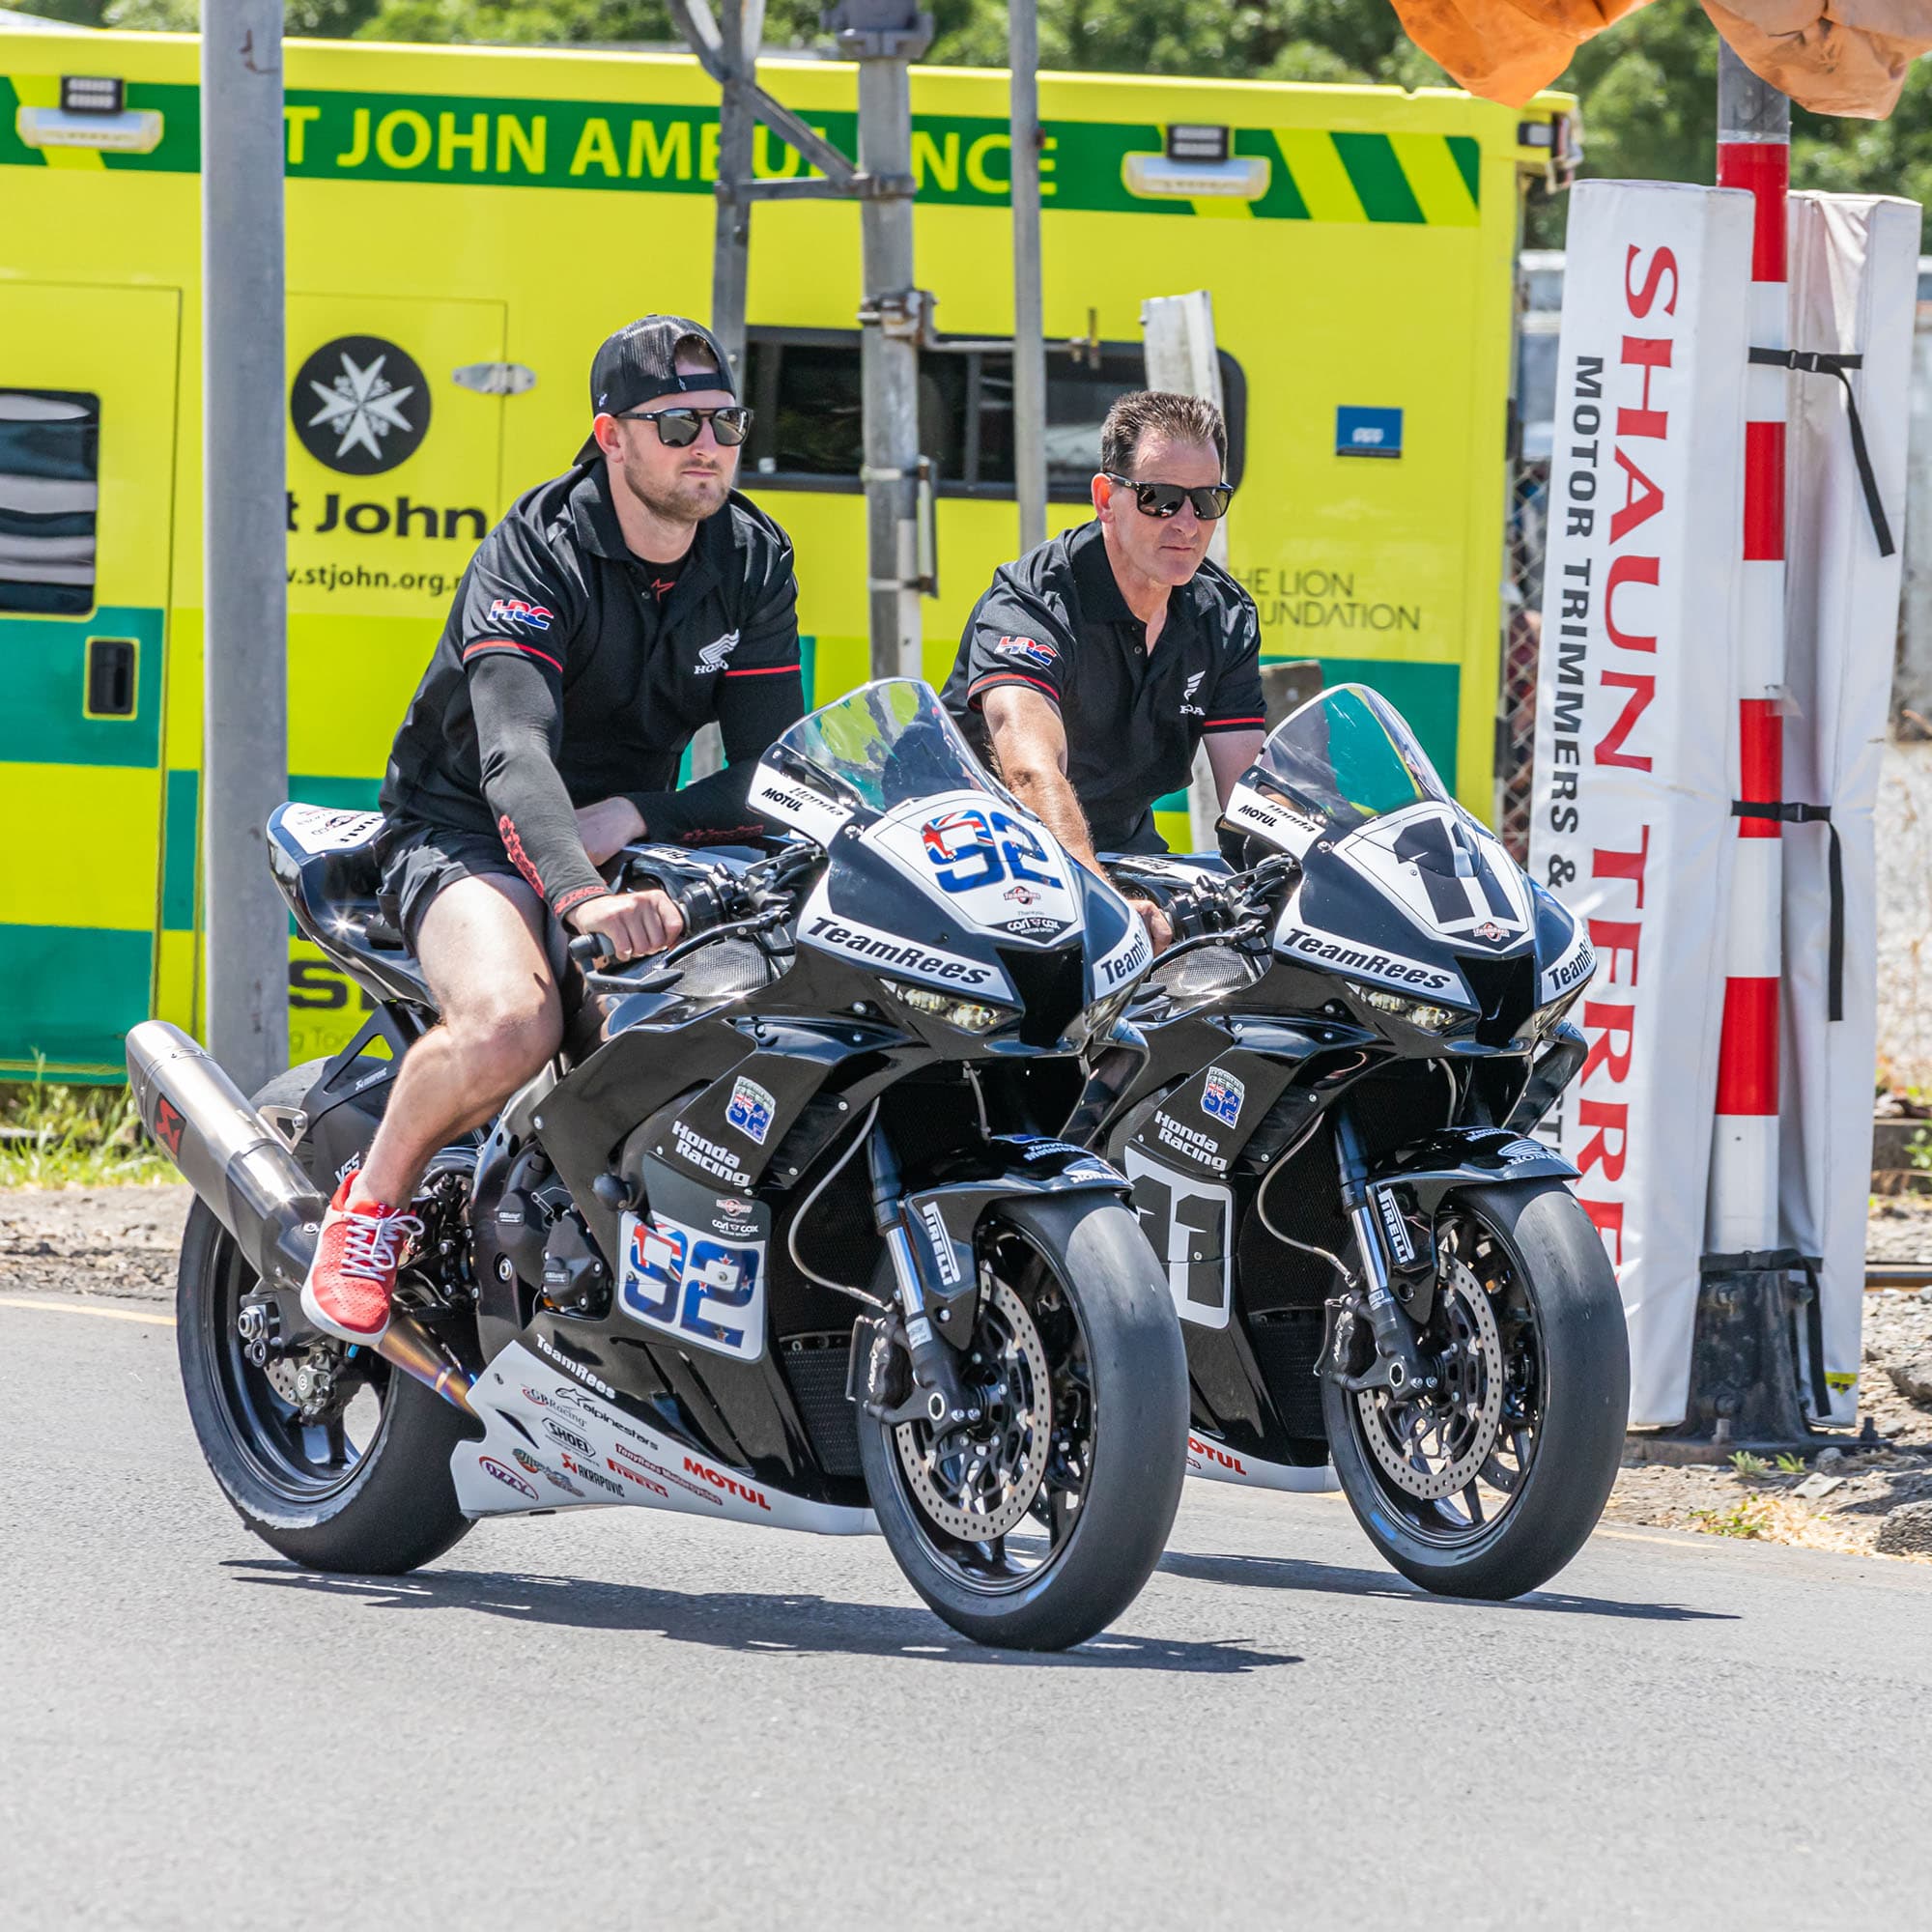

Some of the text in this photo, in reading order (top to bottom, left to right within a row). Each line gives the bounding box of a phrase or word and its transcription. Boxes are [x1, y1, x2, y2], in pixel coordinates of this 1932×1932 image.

[336, 108, 548, 176] JOHN
[315, 493, 488, 540] John
[1595, 243, 1679, 773] SHAUN
[1279, 570, 1354, 597] LION
[487, 599, 554, 630] HRC
[1260, 601, 1420, 631] UNDATION
[1547, 355, 1604, 889] MOTOR TRIMMERS &
[994, 636, 1057, 666] HRC
[761, 787, 804, 811] MOTUL
[1237, 805, 1278, 827] MOTUL
[921, 810, 1065, 894] 92
[808, 916, 992, 984] TeamRees
[1283, 927, 1451, 989] TeamRees
[672, 1121, 741, 1169] Honda
[1154, 1110, 1219, 1153] Honda
[1158, 1126, 1228, 1172] Racing
[675, 1138, 751, 1187] Racing
[923, 1201, 961, 1287] PIRELLI
[1378, 1188, 1415, 1264] PIRELLI
[624, 1221, 760, 1349] 92
[536, 1333, 616, 1400] TeamRees
[549, 1421, 590, 1455] SHOEI
[582, 1404, 659, 1451] alpinestars
[1188, 1436, 1247, 1476] OTUL
[683, 1456, 772, 1512] MOTUL
